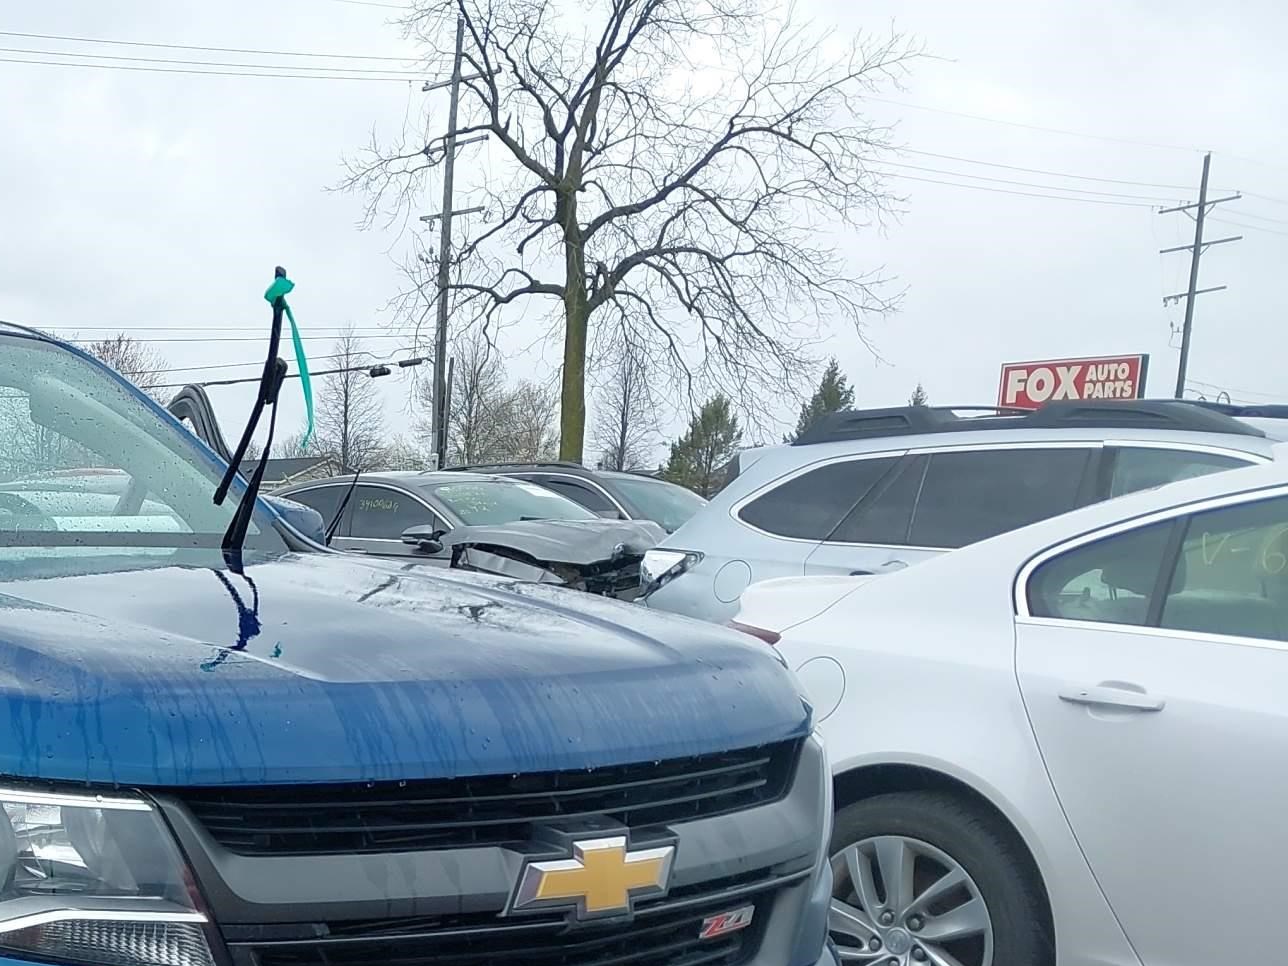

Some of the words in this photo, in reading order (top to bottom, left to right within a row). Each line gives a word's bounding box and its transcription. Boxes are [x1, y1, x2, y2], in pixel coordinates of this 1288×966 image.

[1085, 362, 1130, 382] AUTO
[1006, 365, 1083, 404] FOX
[1083, 380, 1133, 400] PARTS
